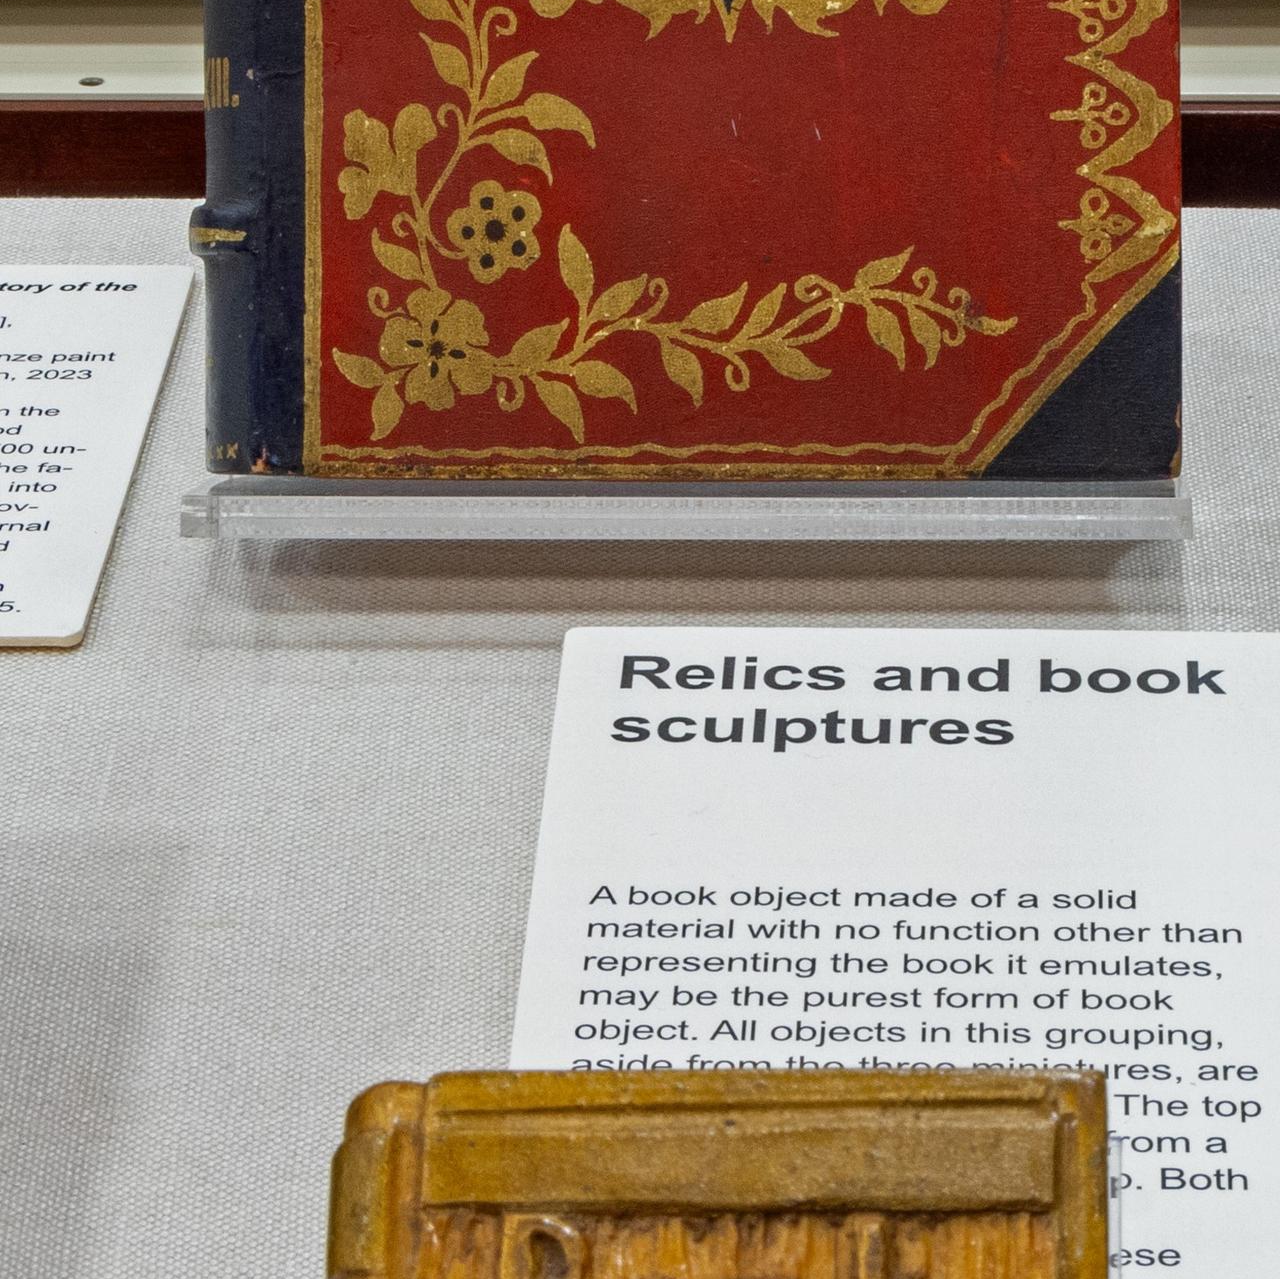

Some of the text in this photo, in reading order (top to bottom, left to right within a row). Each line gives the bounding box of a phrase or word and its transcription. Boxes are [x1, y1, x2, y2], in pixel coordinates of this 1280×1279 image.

[59, 281, 138, 292] of the
[50, 351, 116, 365] paint
[25, 369, 93, 381] 2023
[19, 405, 61, 417] the
[42, 445, 87, 455] un-
[37, 461, 73, 474] fa-
[8, 481, 58, 493] into
[619, 655, 1227, 695] Relics and book
[610, 708, 1015, 753] sculptures
[588, 885, 1137, 912] A book object made of a solid
[587, 918, 1243, 944] material with no function other than
[583, 951, 1222, 981] representing the book it emulates,
[1113, 1093, 1263, 1123] The top
[1159, 1167, 1249, 1191] Both
